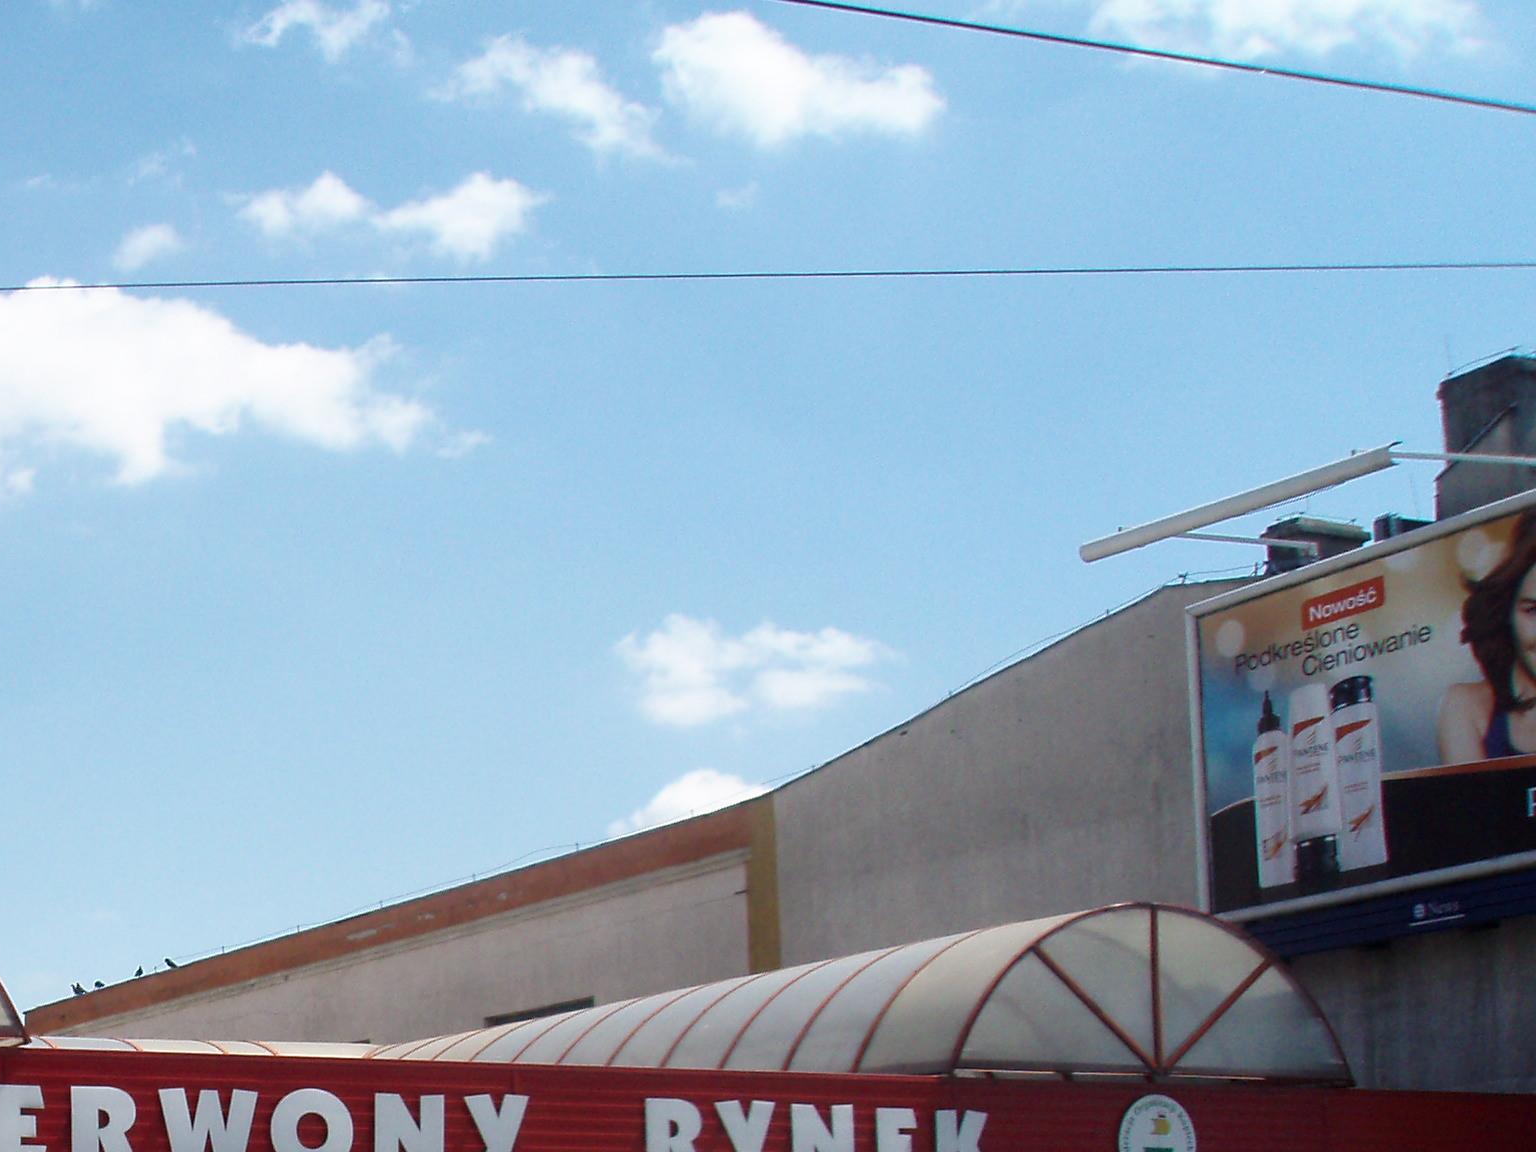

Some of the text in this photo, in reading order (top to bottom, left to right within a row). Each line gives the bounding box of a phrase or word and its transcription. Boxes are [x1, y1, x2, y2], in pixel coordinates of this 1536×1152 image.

[1308, 588, 1378, 622] Nowość
[1235, 623, 1360, 674] Podkreślone
[1301, 624, 1432, 676] Cieniowanie
